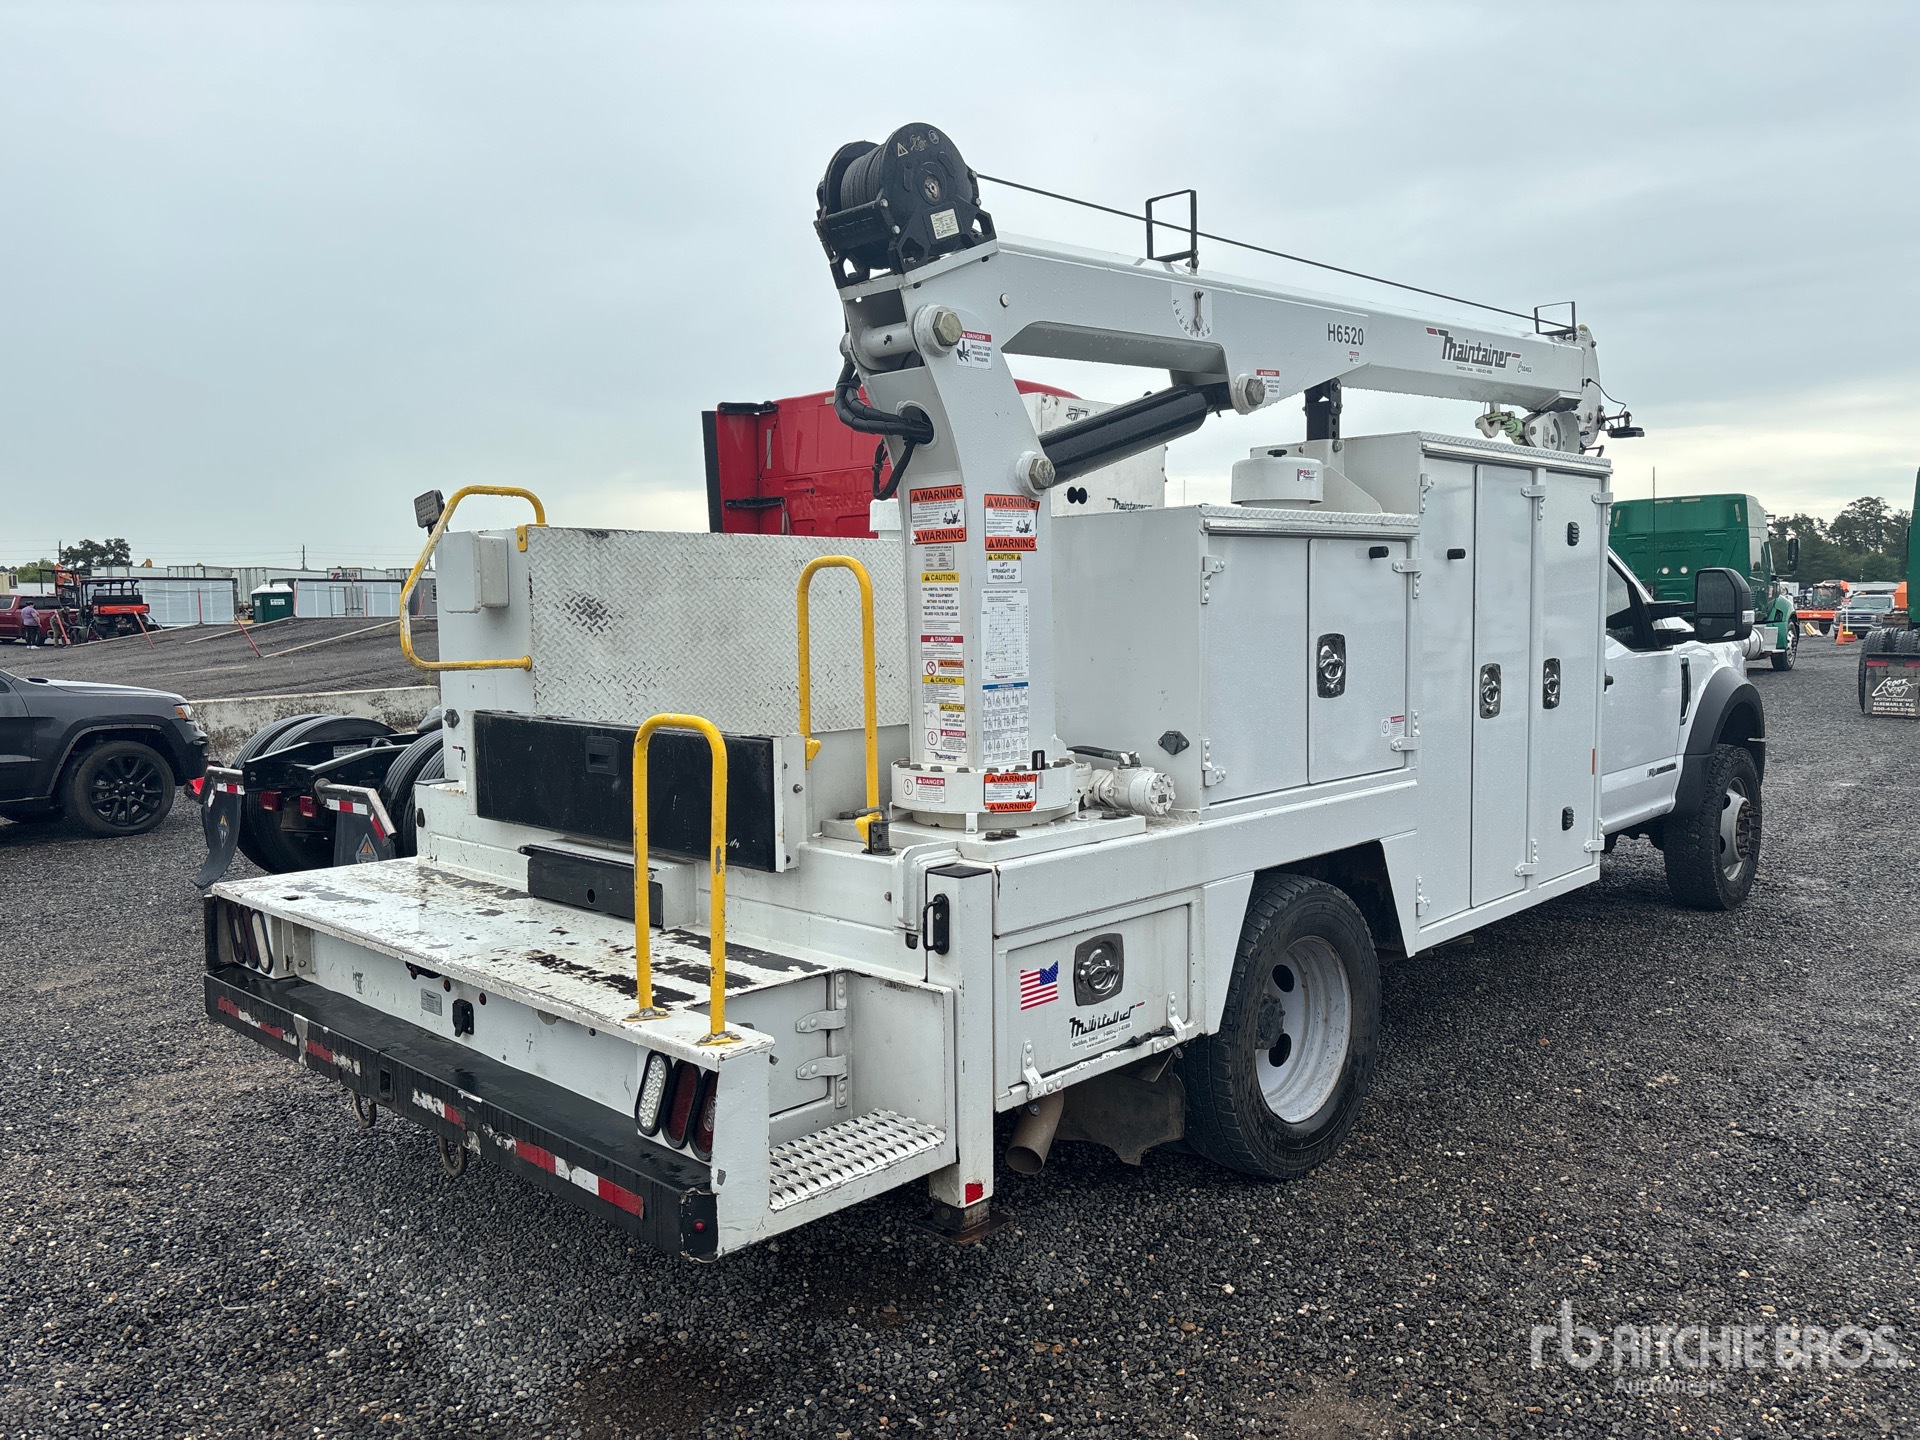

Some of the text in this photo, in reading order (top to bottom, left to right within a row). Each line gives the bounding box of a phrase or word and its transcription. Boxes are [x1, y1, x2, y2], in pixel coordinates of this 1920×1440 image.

[966, 332, 986, 341] DANGER
[1327, 322, 1364, 346] H6520
[1437, 329, 1511, 368] Maintainer
[920, 487, 962, 501] WARNING
[994, 497, 1036, 508] WARNING
[922, 529, 964, 541] WARNING
[995, 538, 1035, 548] WARNING
[996, 774, 1032, 782] WARNING
